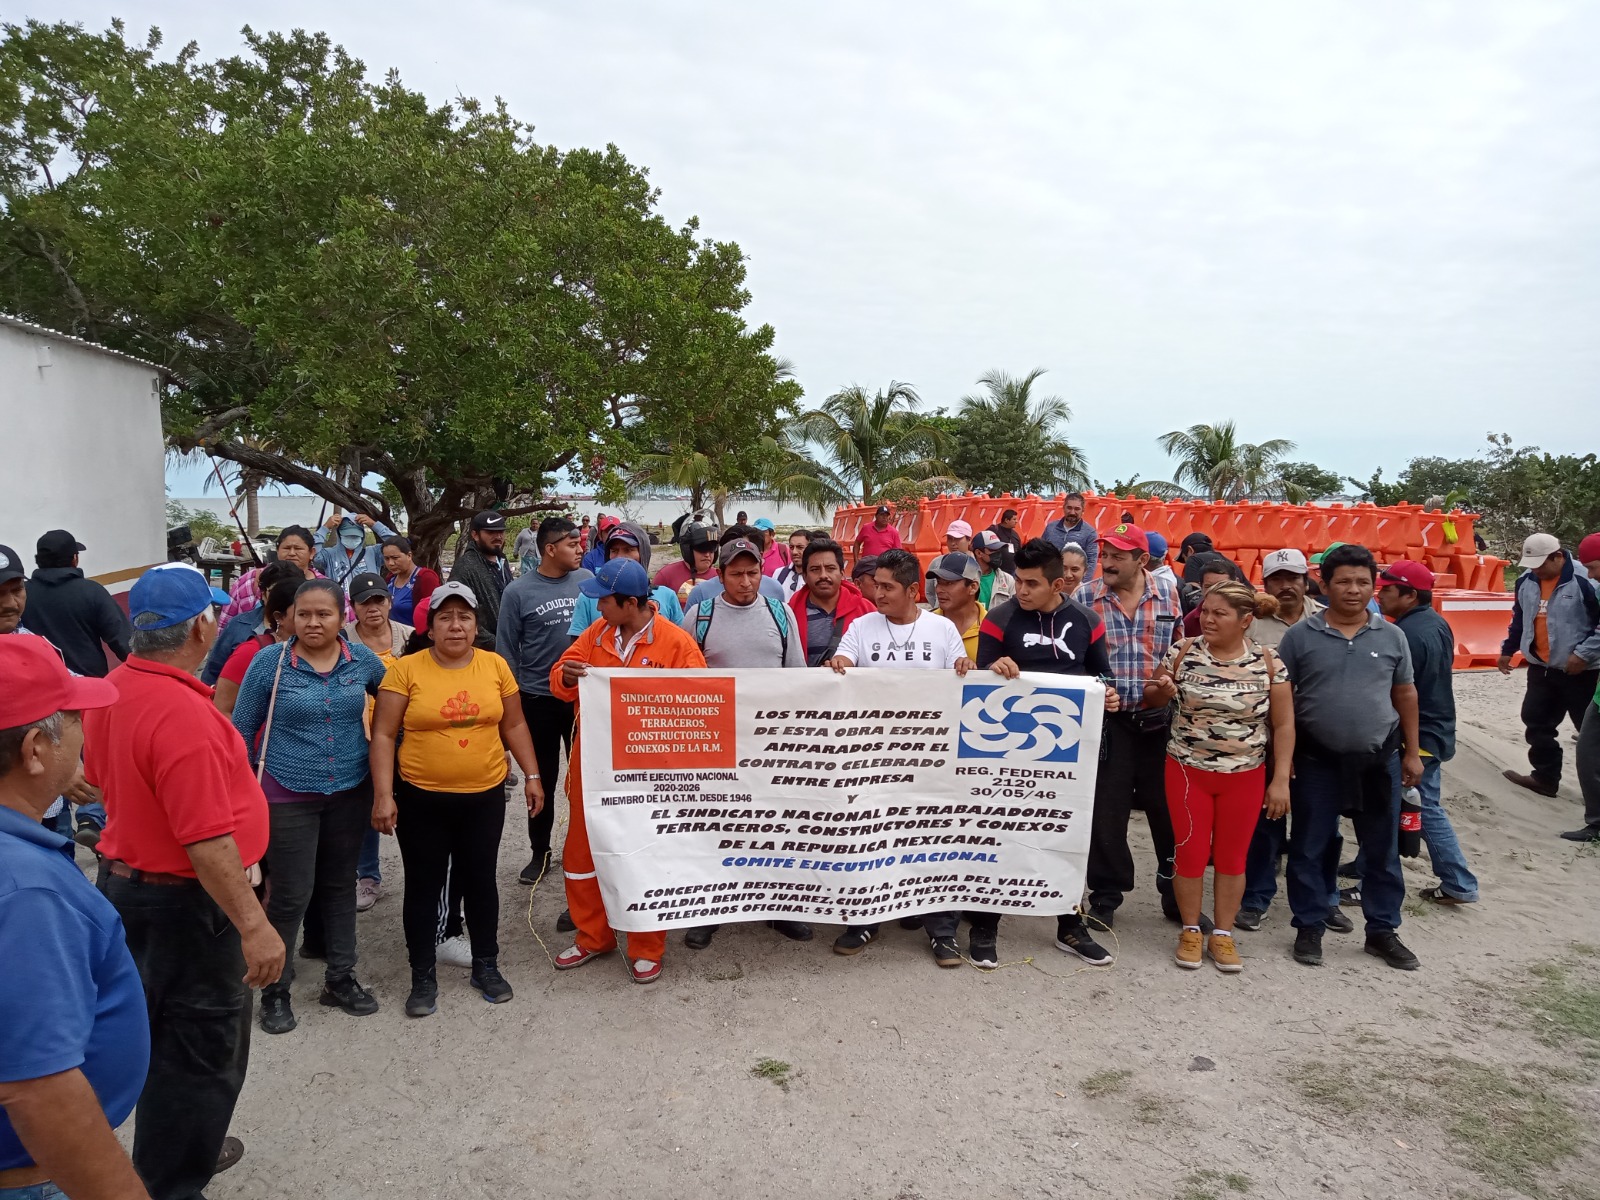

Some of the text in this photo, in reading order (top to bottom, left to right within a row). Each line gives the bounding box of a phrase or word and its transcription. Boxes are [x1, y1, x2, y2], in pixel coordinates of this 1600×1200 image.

[872, 642, 931, 651] GAME
[621, 694, 725, 703] SINDICATO NACIONAL
[627, 706, 719, 716] DE TRABAJADORES
[755, 710, 943, 720] LOS TRABAJADORES
[640, 718, 707, 728] TERRACEROS,
[628, 731, 720, 741] CONSTRUCTORES Y
[754, 726, 950, 737] DE ESTA OBRA ESTAN
[625, 744, 723, 753] CONEXOS DE LA R.M.
[764, 742, 950, 754] AMPARADOS POR EL
[738, 758, 946, 771] CONTRATO CELEBRADO
[614, 772, 738, 782] COMITÉ EJECUTIVO NACIONAL
[955, 767, 1077, 780] REG. FEDERAL
[770, 774, 914, 788] ENTRE EMPRESA
[992, 778, 1036, 788] 2120
[847, 794, 859, 804] Y
[970, 787, 1056, 800] 30/05/46
[601, 794, 752, 806] MIEMBRO DE LA C.T.M. DESDE 1946
[650, 805, 1073, 821] EL SINDICATO NACIONAL DE TRABAJADORES
[656, 818, 1068, 836] TERRACEROS, CONSTRUCTORES Y CONEXOS
[718, 835, 1002, 854] DE LA REPUBLICA MEXICANA.
[722, 851, 998, 872] COMITÉ EJECUTIVO NACIONAL
[644, 882, 739, 898] CONCEPCION
[743, 882, 822, 892] BEISTEGUI
[898, 874, 958, 886] COLONIA
[964, 875, 991, 883] DEL
[998, 878, 1048, 888] VALLE,
[626, 897, 706, 912] ALCALDIA
[712, 893, 766, 904] BENITO
[770, 893, 834, 905] JUAREZ,
[836, 894, 890, 906] CIUDAD
[894, 890, 911, 899] DE
[976, 887, 1004, 896] C.P.
[1009, 890, 1063, 898] 03100.
[657, 906, 738, 921] TELEFONOS
[742, 903, 809, 913] OFICINA:
[813, 907, 834, 915] 55
[838, 900, 912, 916] 55435145
[916, 898, 925, 906] Y
[928, 895, 947, 904] 55
